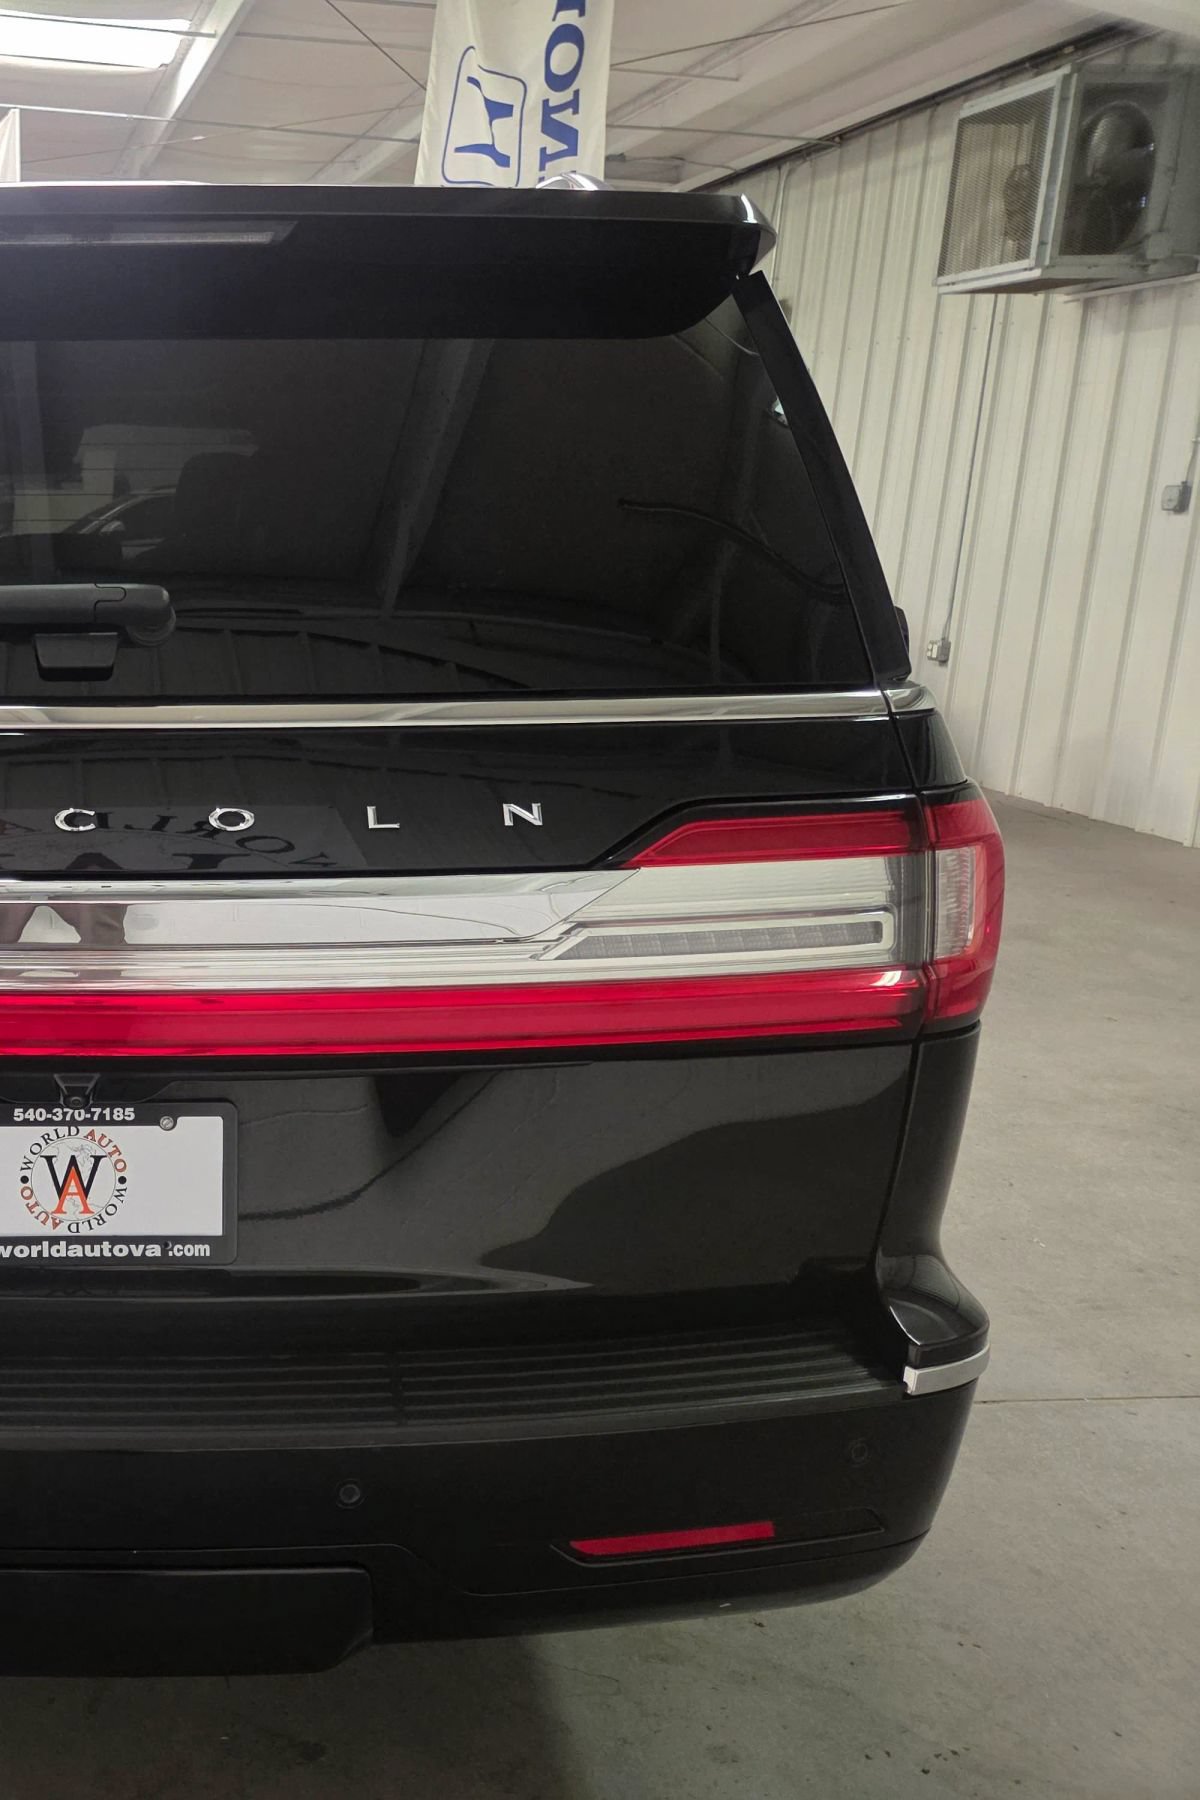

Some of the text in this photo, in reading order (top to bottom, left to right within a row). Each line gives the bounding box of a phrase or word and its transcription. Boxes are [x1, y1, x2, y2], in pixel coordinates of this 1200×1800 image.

[13, 1107, 136, 1121] 540-370-7185
[20, 1125, 128, 1173] WORLD AUTO
[20, 1186, 128, 1234] WORLD AUTO
